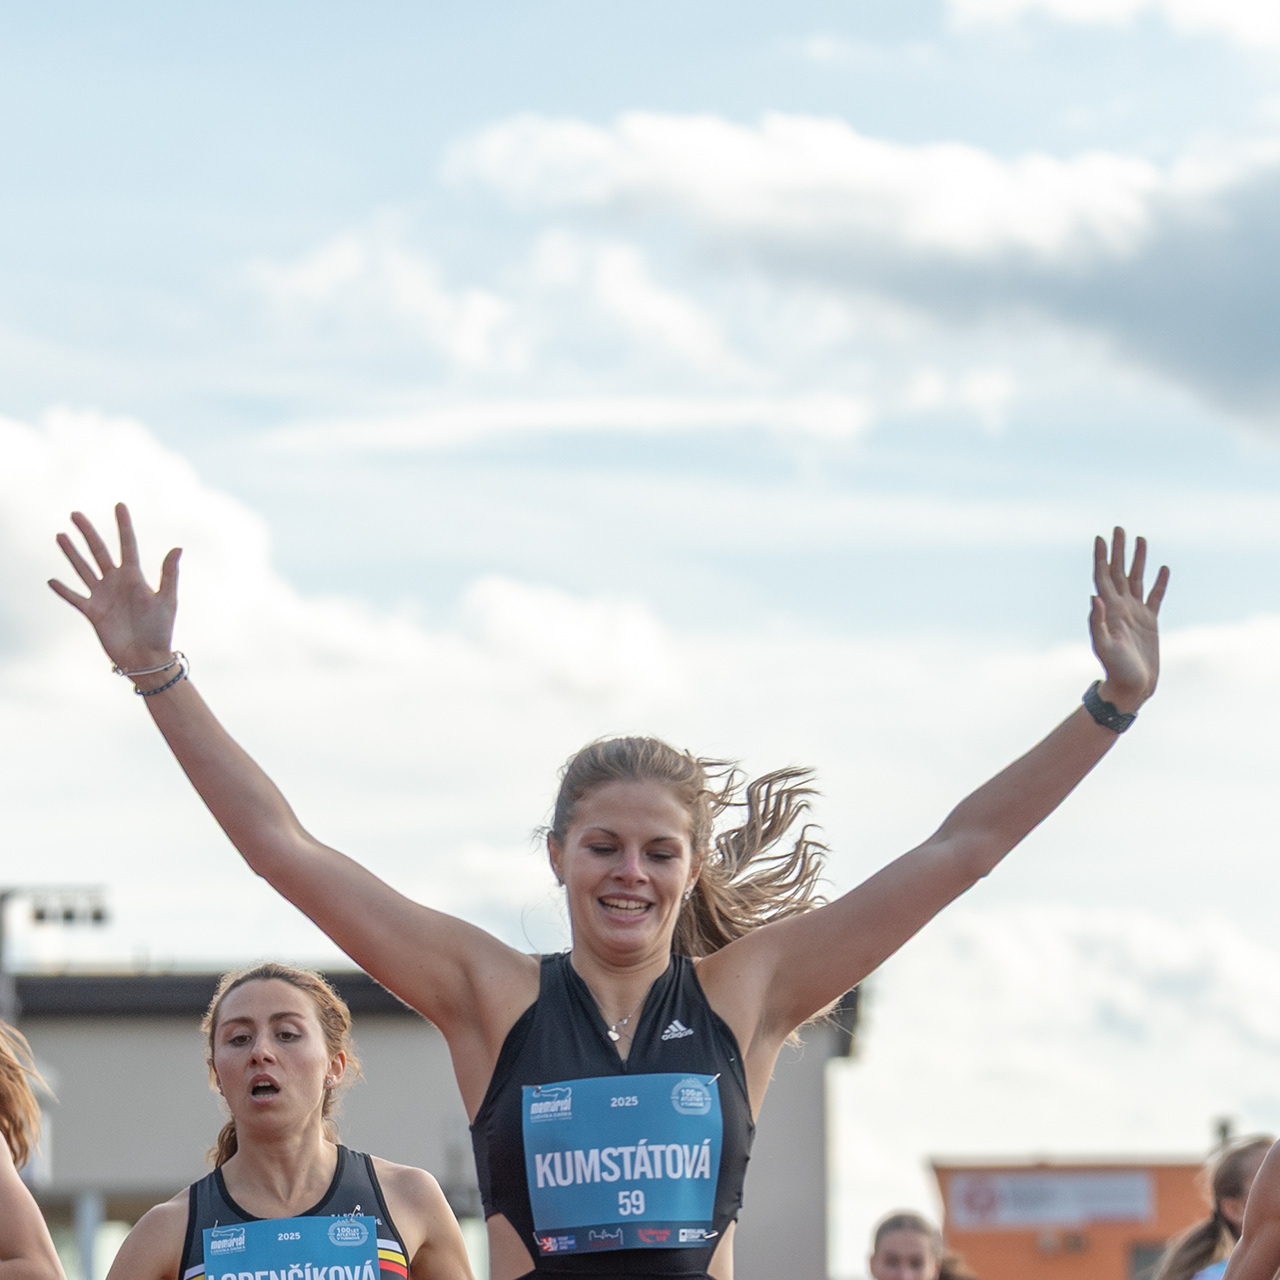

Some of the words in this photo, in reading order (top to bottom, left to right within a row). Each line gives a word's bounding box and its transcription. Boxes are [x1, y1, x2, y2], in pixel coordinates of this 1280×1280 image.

[661, 1028, 695, 1041] adidas
[610, 1096, 639, 1108] 2025
[534, 1138, 712, 1189] KUMSTÁTOVÁ
[617, 1189, 646, 1216] 59
[277, 1232, 301, 1241] 2025
